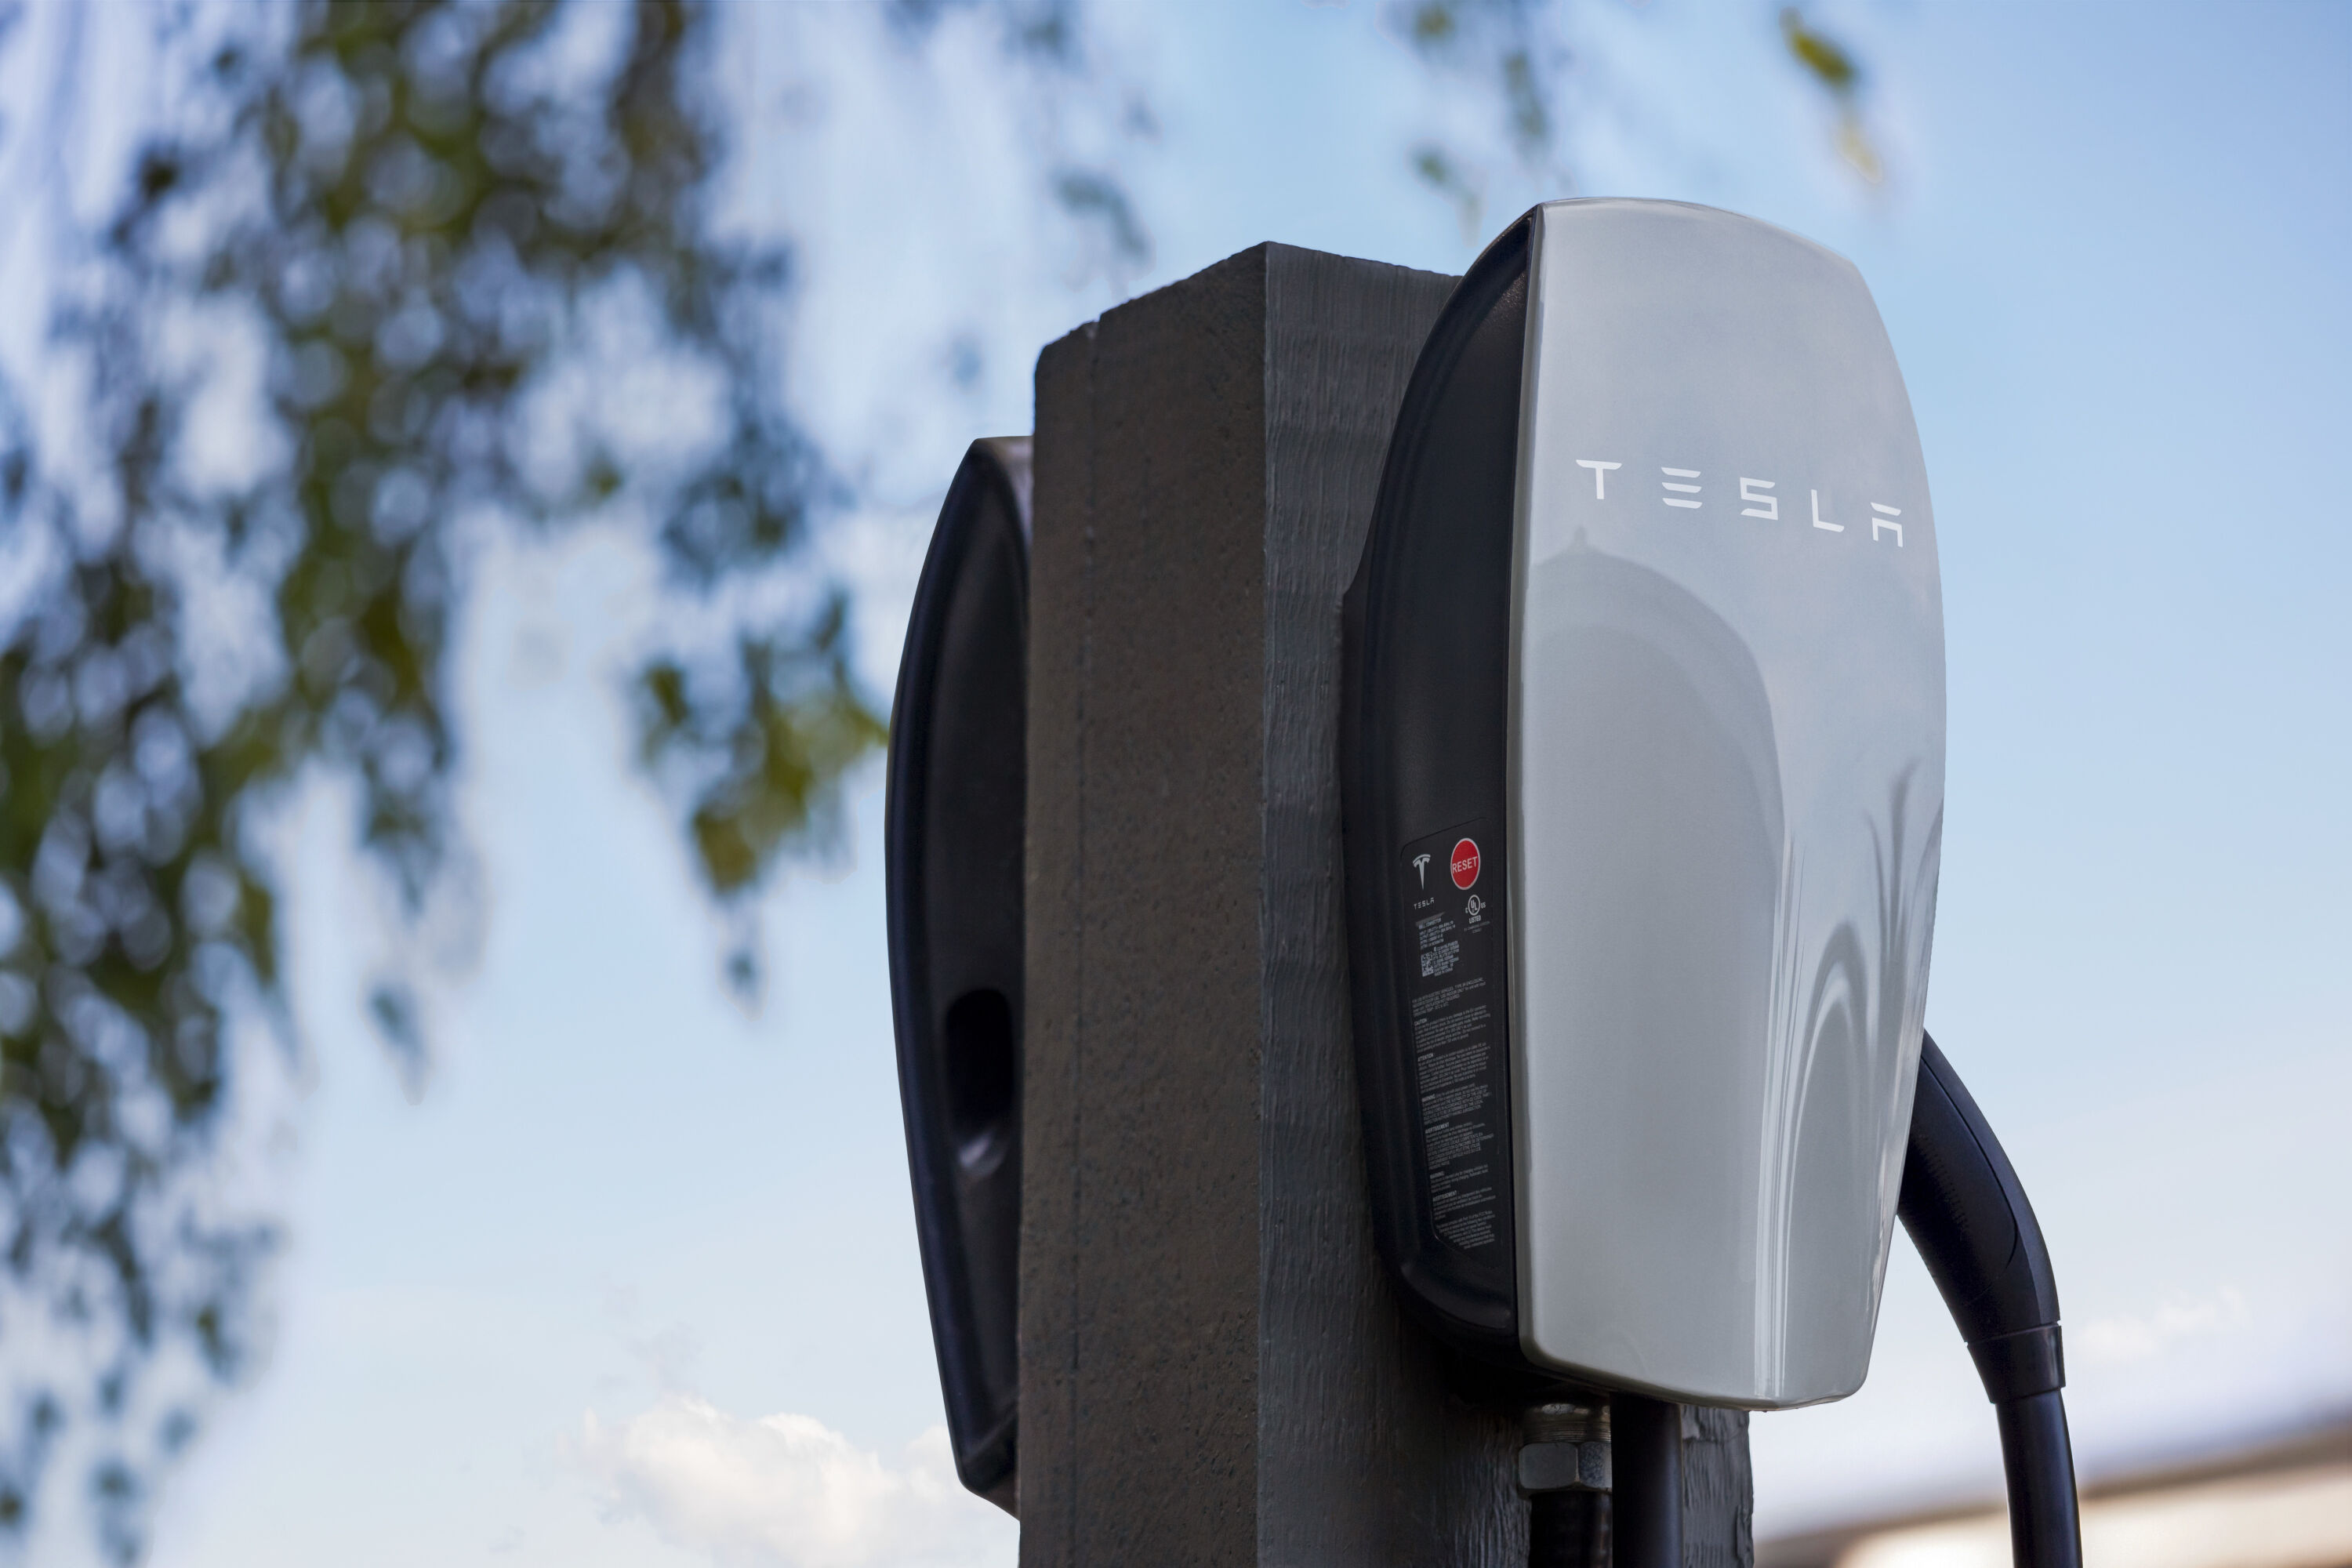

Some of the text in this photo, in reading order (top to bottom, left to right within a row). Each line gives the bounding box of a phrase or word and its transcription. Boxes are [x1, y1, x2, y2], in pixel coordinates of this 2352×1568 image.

[1575, 459, 1904, 548] TESLA
[1452, 856, 1478, 874] RESET
[1414, 897, 1435, 910] TESLA
[1468, 915, 1482, 924] LISTED
